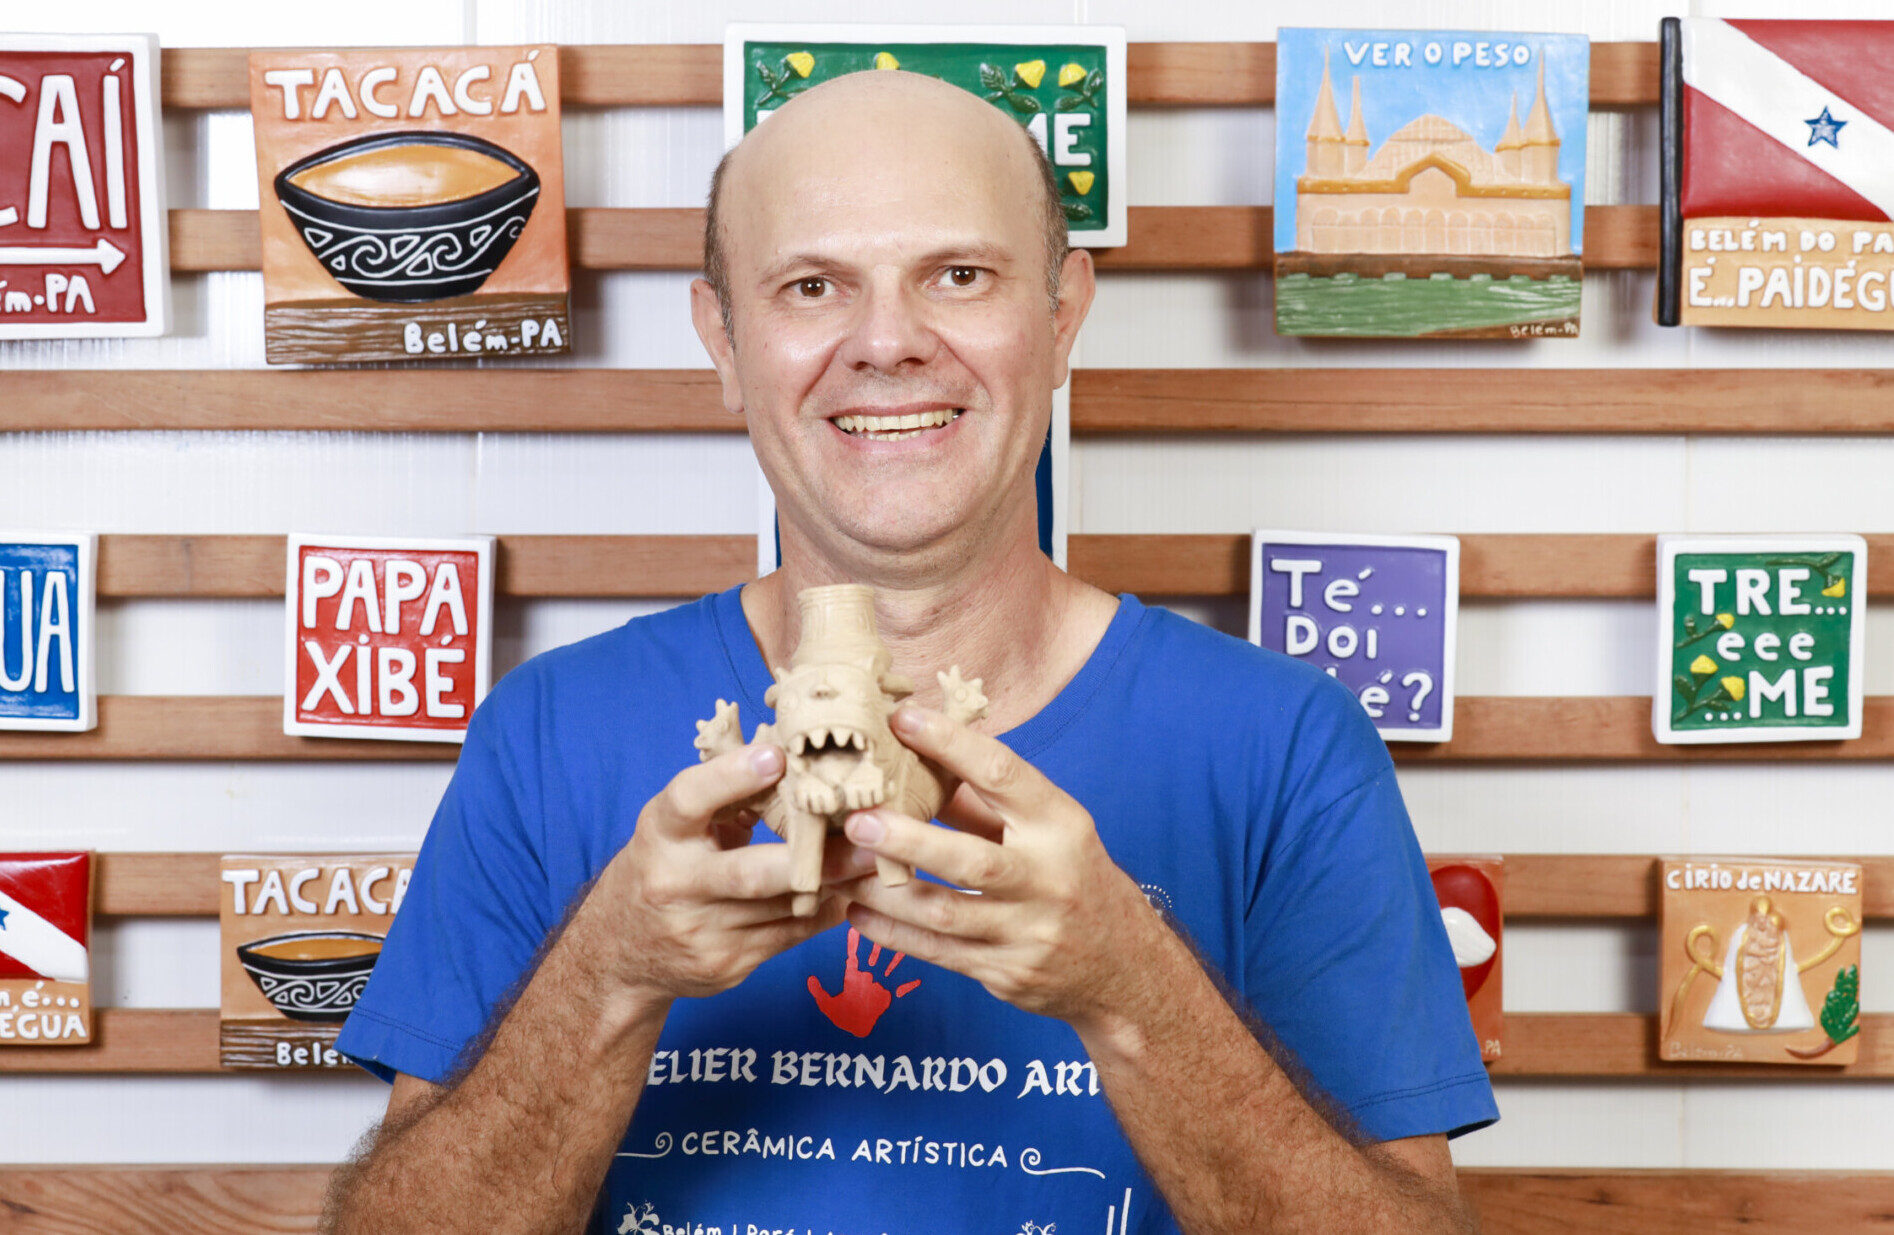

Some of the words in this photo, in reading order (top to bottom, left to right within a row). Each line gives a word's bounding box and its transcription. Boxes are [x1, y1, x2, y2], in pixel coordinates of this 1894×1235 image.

[1344, 41, 1412, 68] VER
[1424, 42, 1442, 64] O
[1453, 42, 1530, 68] PESO
[264, 49, 546, 119] TACACÁ
[1690, 219, 1786, 253] BELÉM
[1800, 231, 1836, 251] DO
[404, 318, 563, 354] Belém-PA
[304, 555, 469, 636] PAPA
[1271, 558, 1428, 617] Té...
[1688, 568, 1848, 616] TRE...
[770, 1050, 1007, 1095] BERNARDO
[681, 1128, 836, 1161] CERÂMICA
[851, 1136, 1008, 1168] ARTÍSTICA
